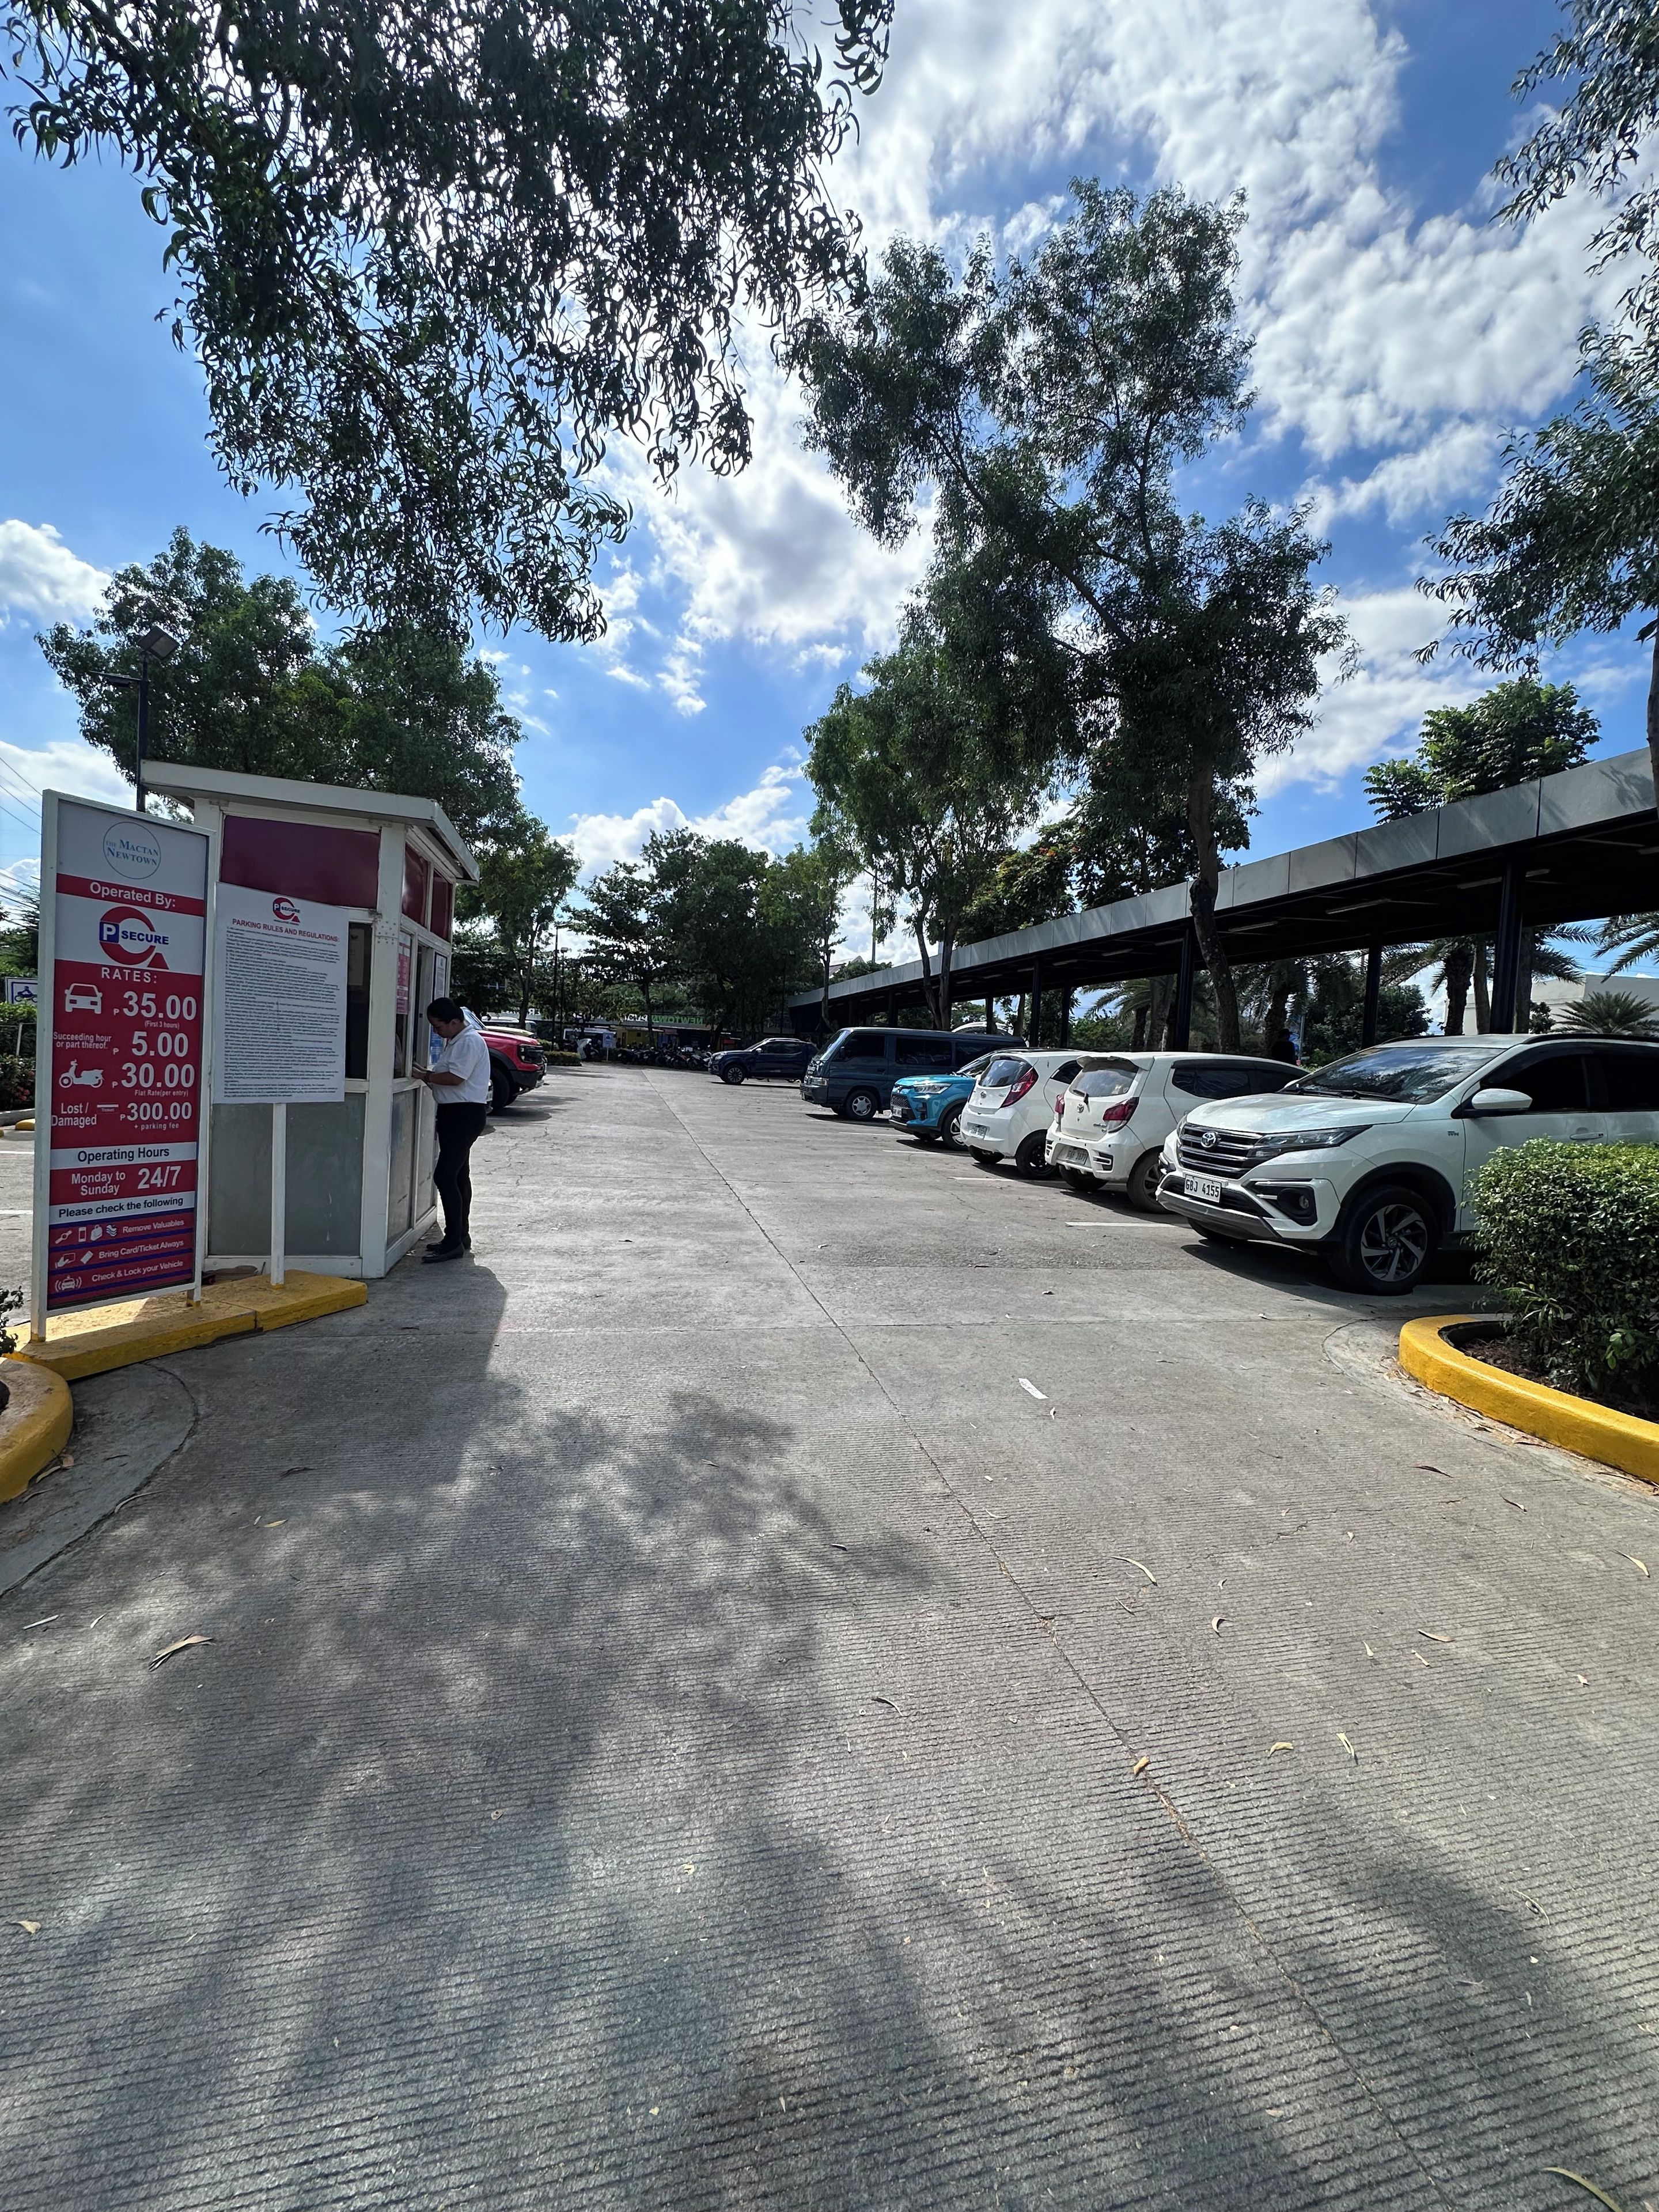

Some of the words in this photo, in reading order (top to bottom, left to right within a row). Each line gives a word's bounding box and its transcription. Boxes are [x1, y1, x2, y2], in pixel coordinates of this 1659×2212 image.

[108, 847, 157, 866] NEWTOWN
[120, 839, 158, 856] MACTAN
[90, 882, 151, 903] Operated
[156, 893, 176, 908] By:
[103, 923, 116, 941] P
[121, 930, 169, 945] SECURE
[232, 918, 262, 929] PARKING
[263, 924, 283, 933] RULES
[298, 930, 340, 942] REGULATIONS:
[101, 967, 157, 984] RATES:
[123, 991, 197, 1020] 35.00
[54, 1032, 94, 1043] Succeeding
[96, 1033, 112, 1042] hour
[66, 1041, 81, 1050] part
[131, 1031, 189, 1057] 5.00
[122, 1062, 195, 1088] 30.00
[60, 1103, 84, 1114] Lost
[127, 1101, 192, 1121] 300.00
[51, 1114, 97, 1128] Damaged
[141, 1123, 166, 1131] parking
[78, 1148, 134, 1164] Operating
[138, 1147, 170, 1158] Hours
[71, 1172, 113, 1184] Monday
[115, 1171, 126, 1180] to
[138, 1165, 181, 1190] 24/7
[80, 1184, 120, 1196] Sunday
[1185, 1179, 1198, 1192] GBJ
[1202, 1183, 1219, 1198] 4155
[59, 1208, 93, 1218] Please
[96, 1203, 124, 1214] check
[127, 1202, 141, 1210] the
[144, 1197, 183, 1209] following
[123, 1224, 151, 1233] Remove
[152, 1219, 184, 1229] Valuables
[99, 1249, 119, 1259] Bring
[120, 1244, 160, 1256] Card/Ticket
[160, 1240, 184, 1249] Always
[92, 1271, 115, 1282] Check
[124, 1267, 142, 1276] Lock
[142, 1264, 158, 1274] your
[159, 1260, 183, 1270] Vehicle
